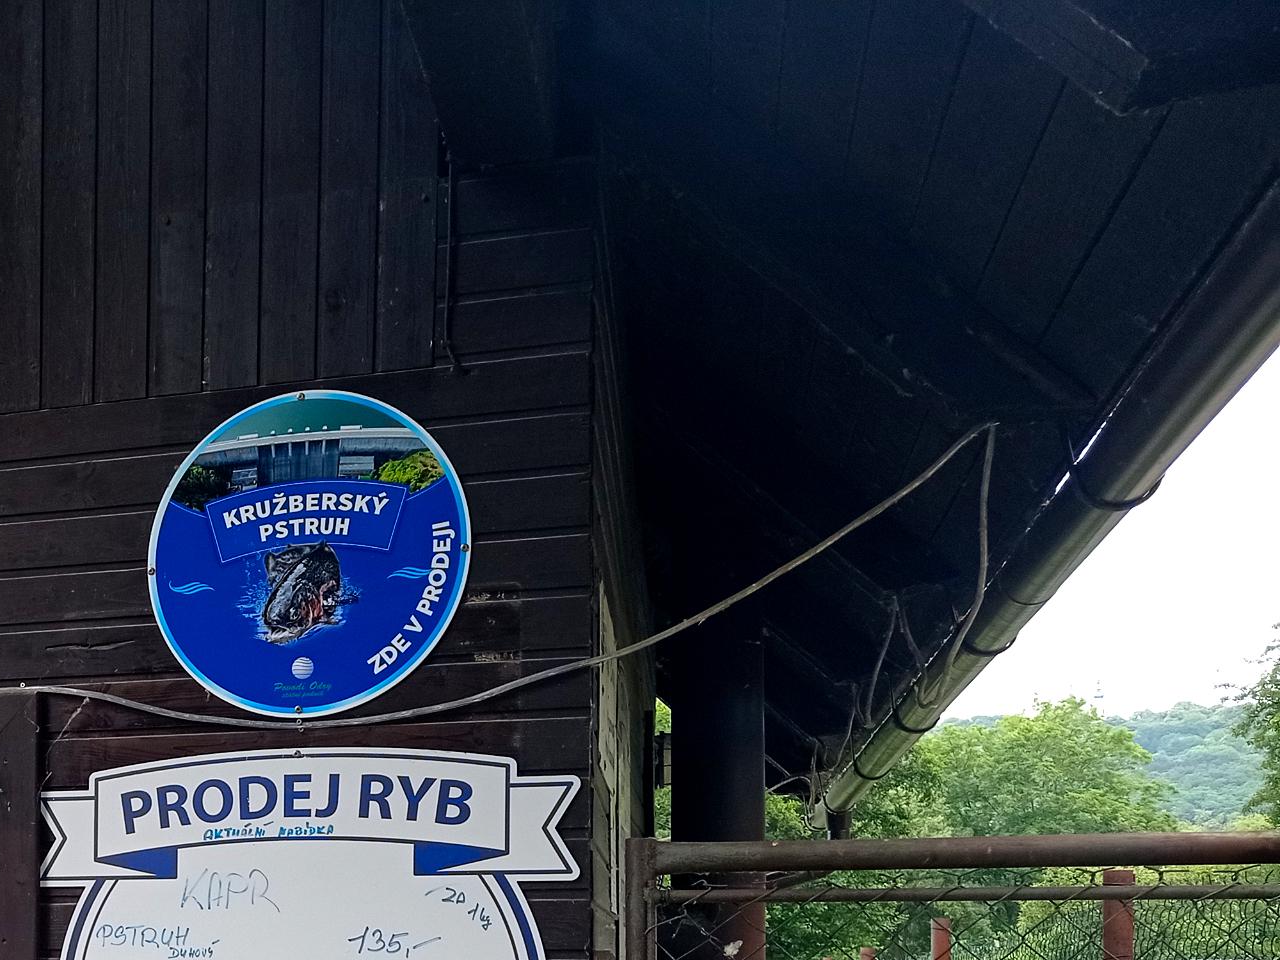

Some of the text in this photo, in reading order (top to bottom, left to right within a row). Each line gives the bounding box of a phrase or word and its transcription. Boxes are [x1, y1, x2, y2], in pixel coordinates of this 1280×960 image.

[222, 492, 390, 529] KRUŽBERSKÝ
[258, 517, 351, 542] PSTRUH
[366, 521, 456, 675] ZDE V PRODEJI
[120, 773, 474, 835] PRODEJ RYB
[180, 867, 281, 913] KAPR
[96, 924, 190, 948] PSTRUH
